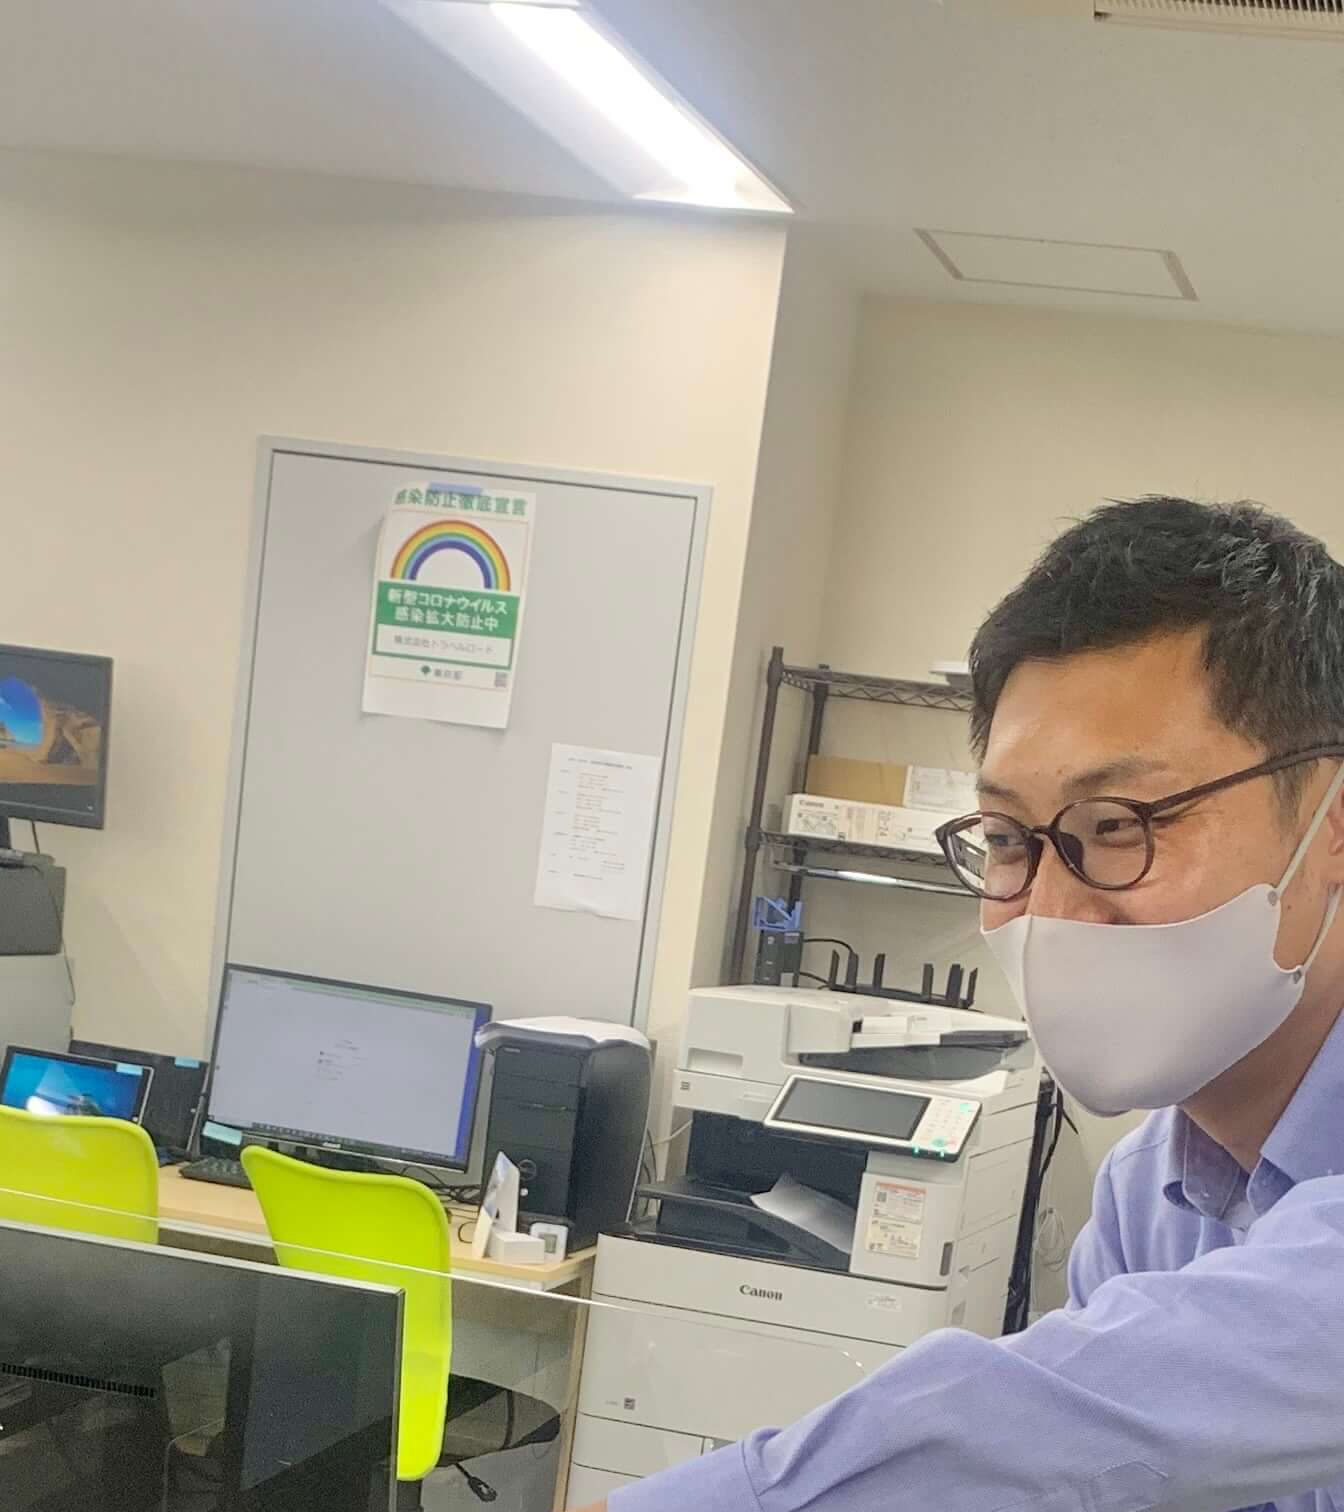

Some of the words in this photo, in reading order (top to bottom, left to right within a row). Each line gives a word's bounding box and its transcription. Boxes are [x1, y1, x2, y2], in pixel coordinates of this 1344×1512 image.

[388, 588, 508, 615] 新型コロナウイルス
[394, 607, 499, 632] 感染拡大防止中
[739, 1284, 784, 1301] Canon
